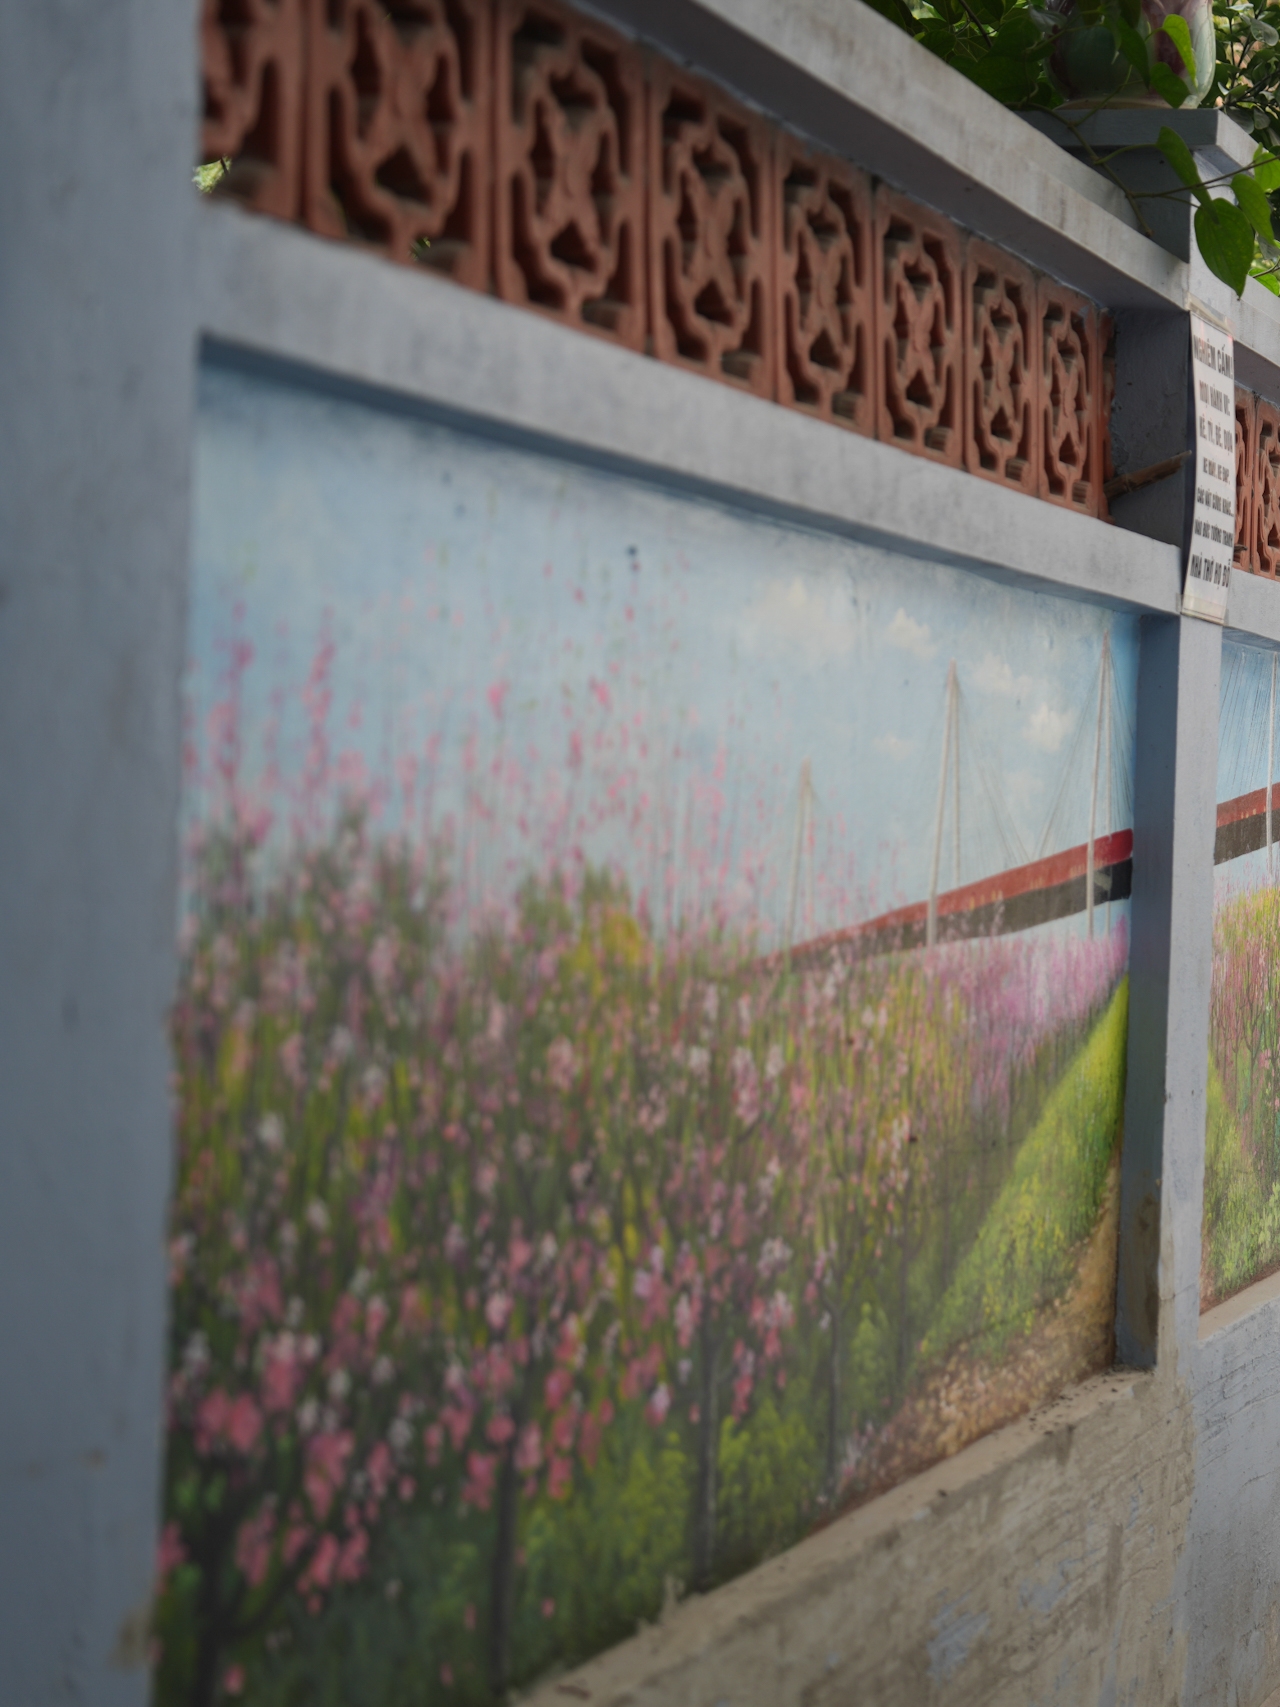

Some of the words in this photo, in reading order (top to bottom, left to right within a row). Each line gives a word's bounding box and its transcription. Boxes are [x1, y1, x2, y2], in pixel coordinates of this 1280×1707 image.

[1194, 335, 1216, 370] NGHIÊM
[1190, 552, 1202, 579] NHÀ
[1203, 556, 1214, 582] THỜ
[1214, 562, 1222, 589] HỌ
